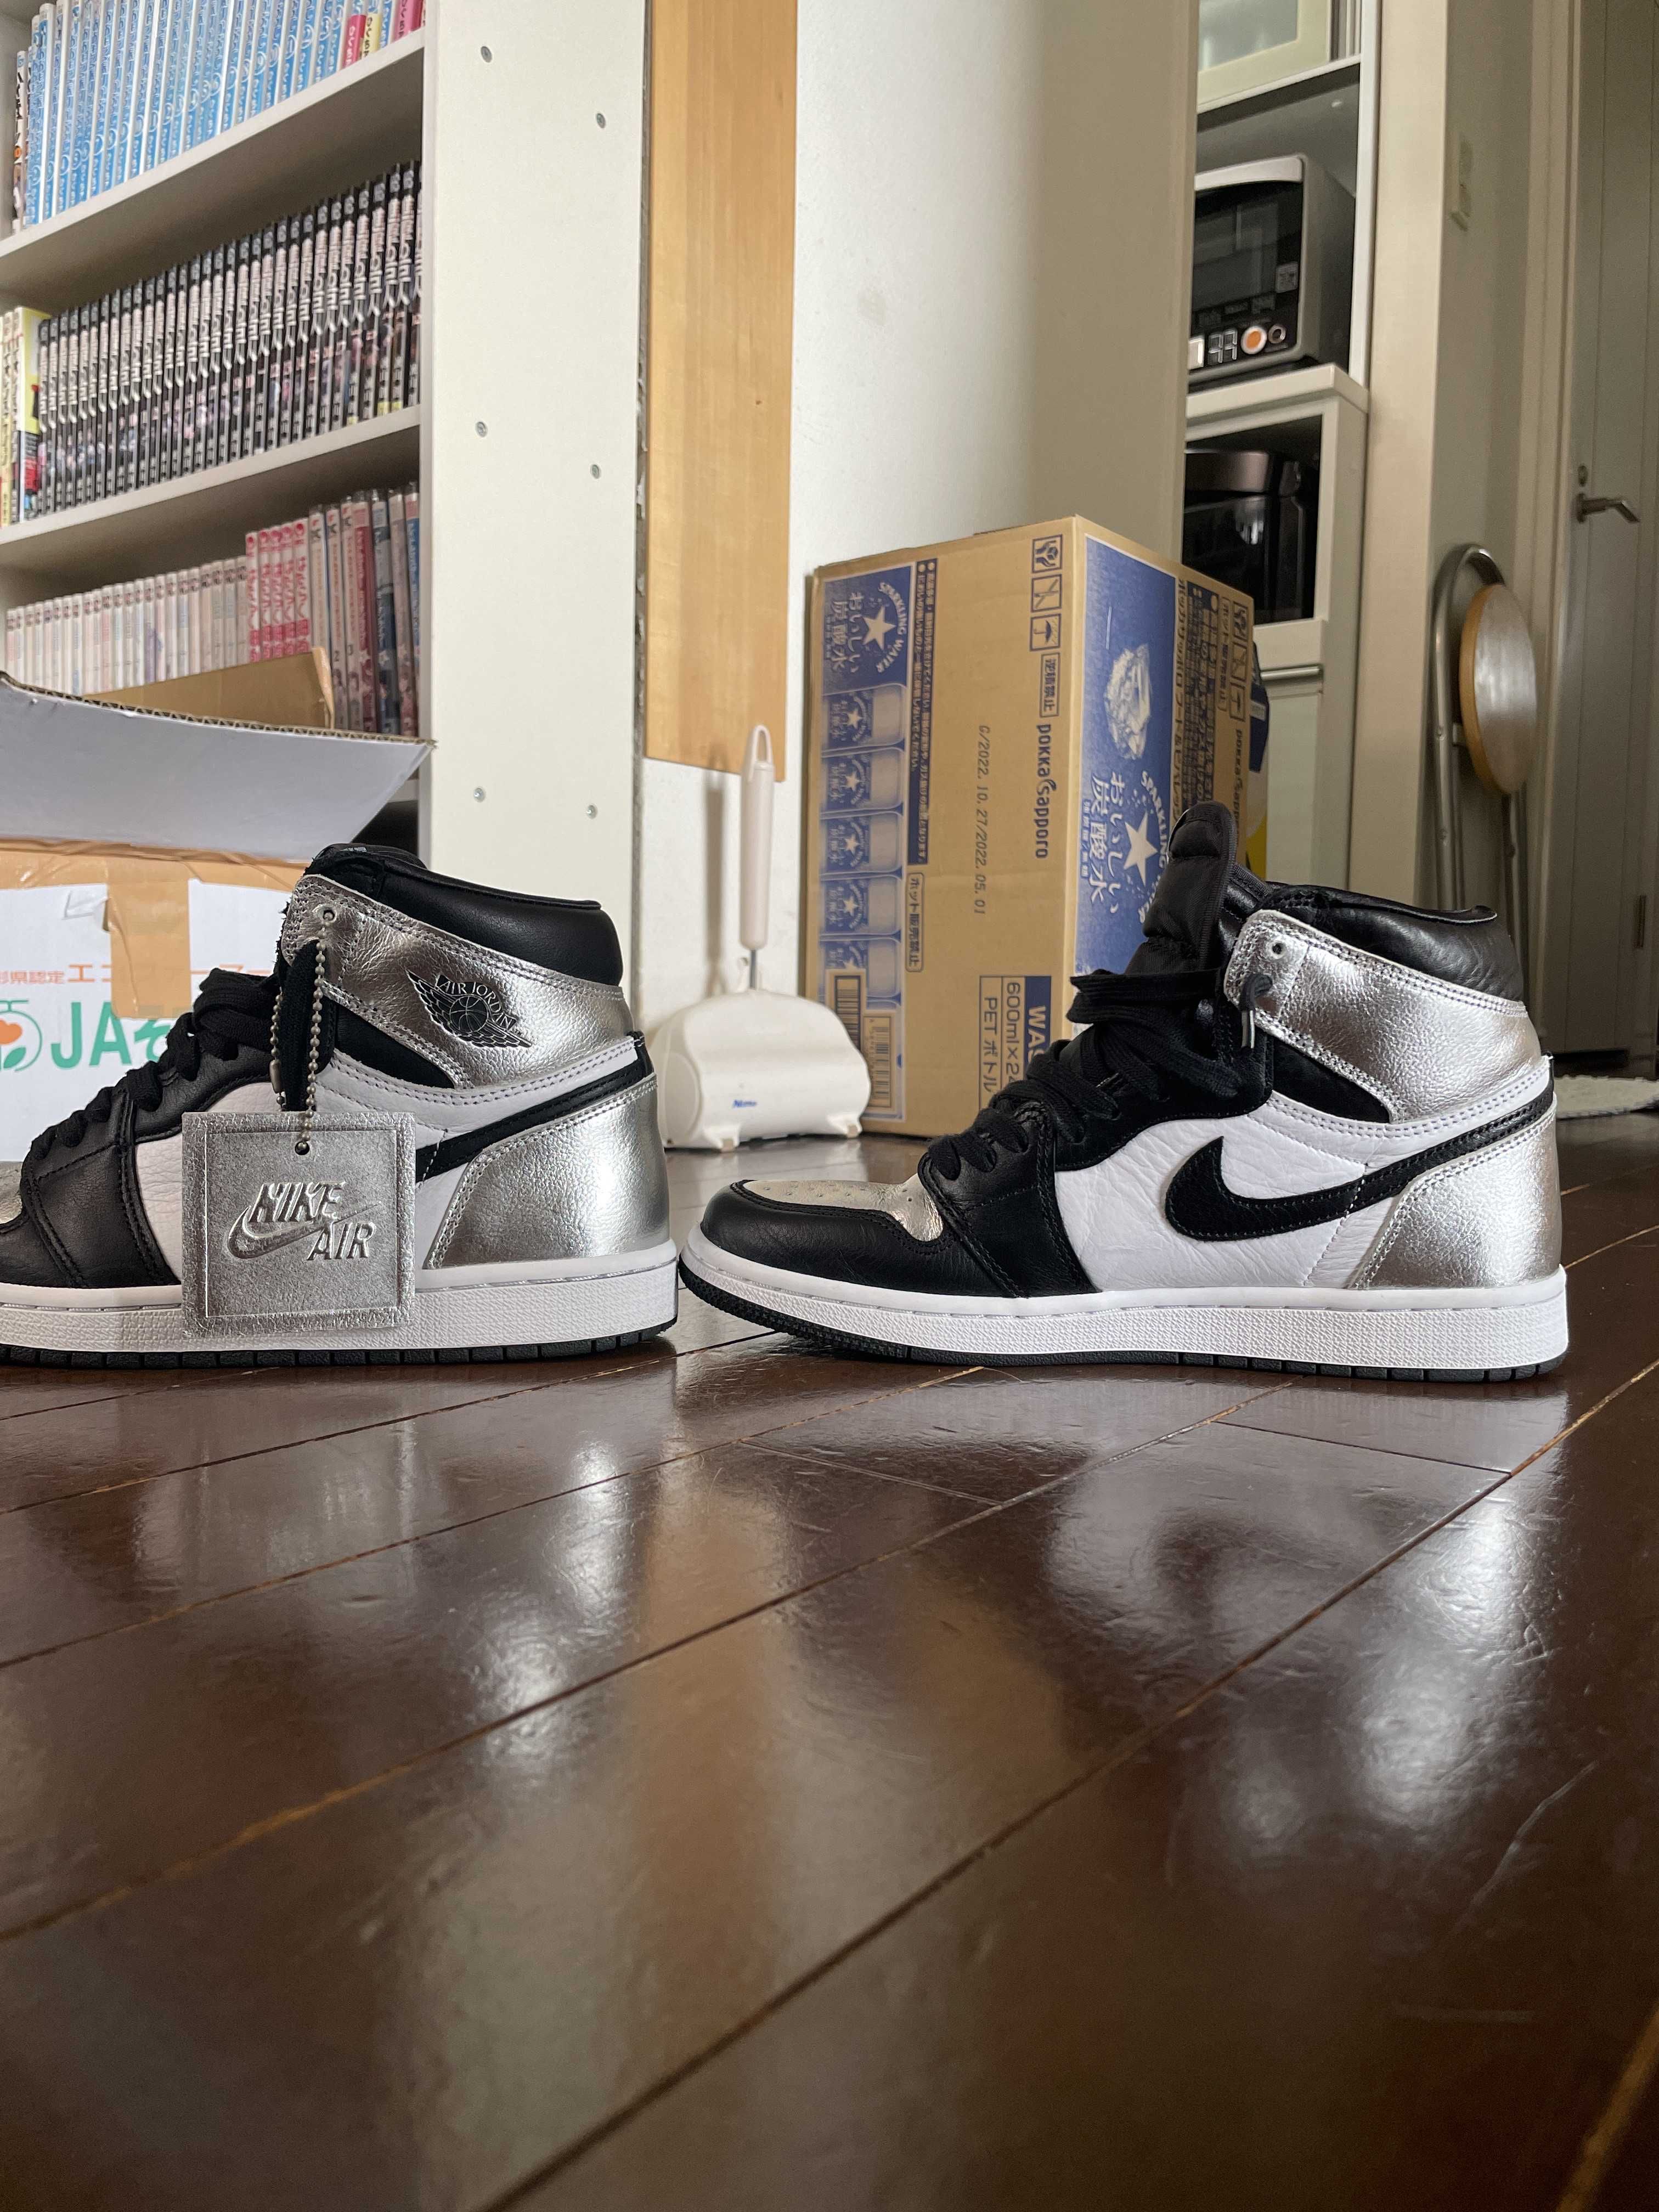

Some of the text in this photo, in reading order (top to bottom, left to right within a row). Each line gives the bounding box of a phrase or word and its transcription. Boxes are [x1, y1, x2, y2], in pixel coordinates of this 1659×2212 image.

[831, 601, 849, 673] 炭酸水
[848, 591, 865, 674] おいしい
[876, 582, 907, 674] SPARKLING WATER
[1089, 771, 1110, 905] 炭酸水
[1108, 771, 1125, 914] おいしい
[1141, 770, 1168, 868] SPARKLING
[438, 980, 467, 994] AIR
[472, 981, 513, 1030] JORDAN
[983, 996, 998, 1093] PET ボトル
[248, 1181, 346, 1223] NIKE
[306, 1221, 377, 1261] AIR
